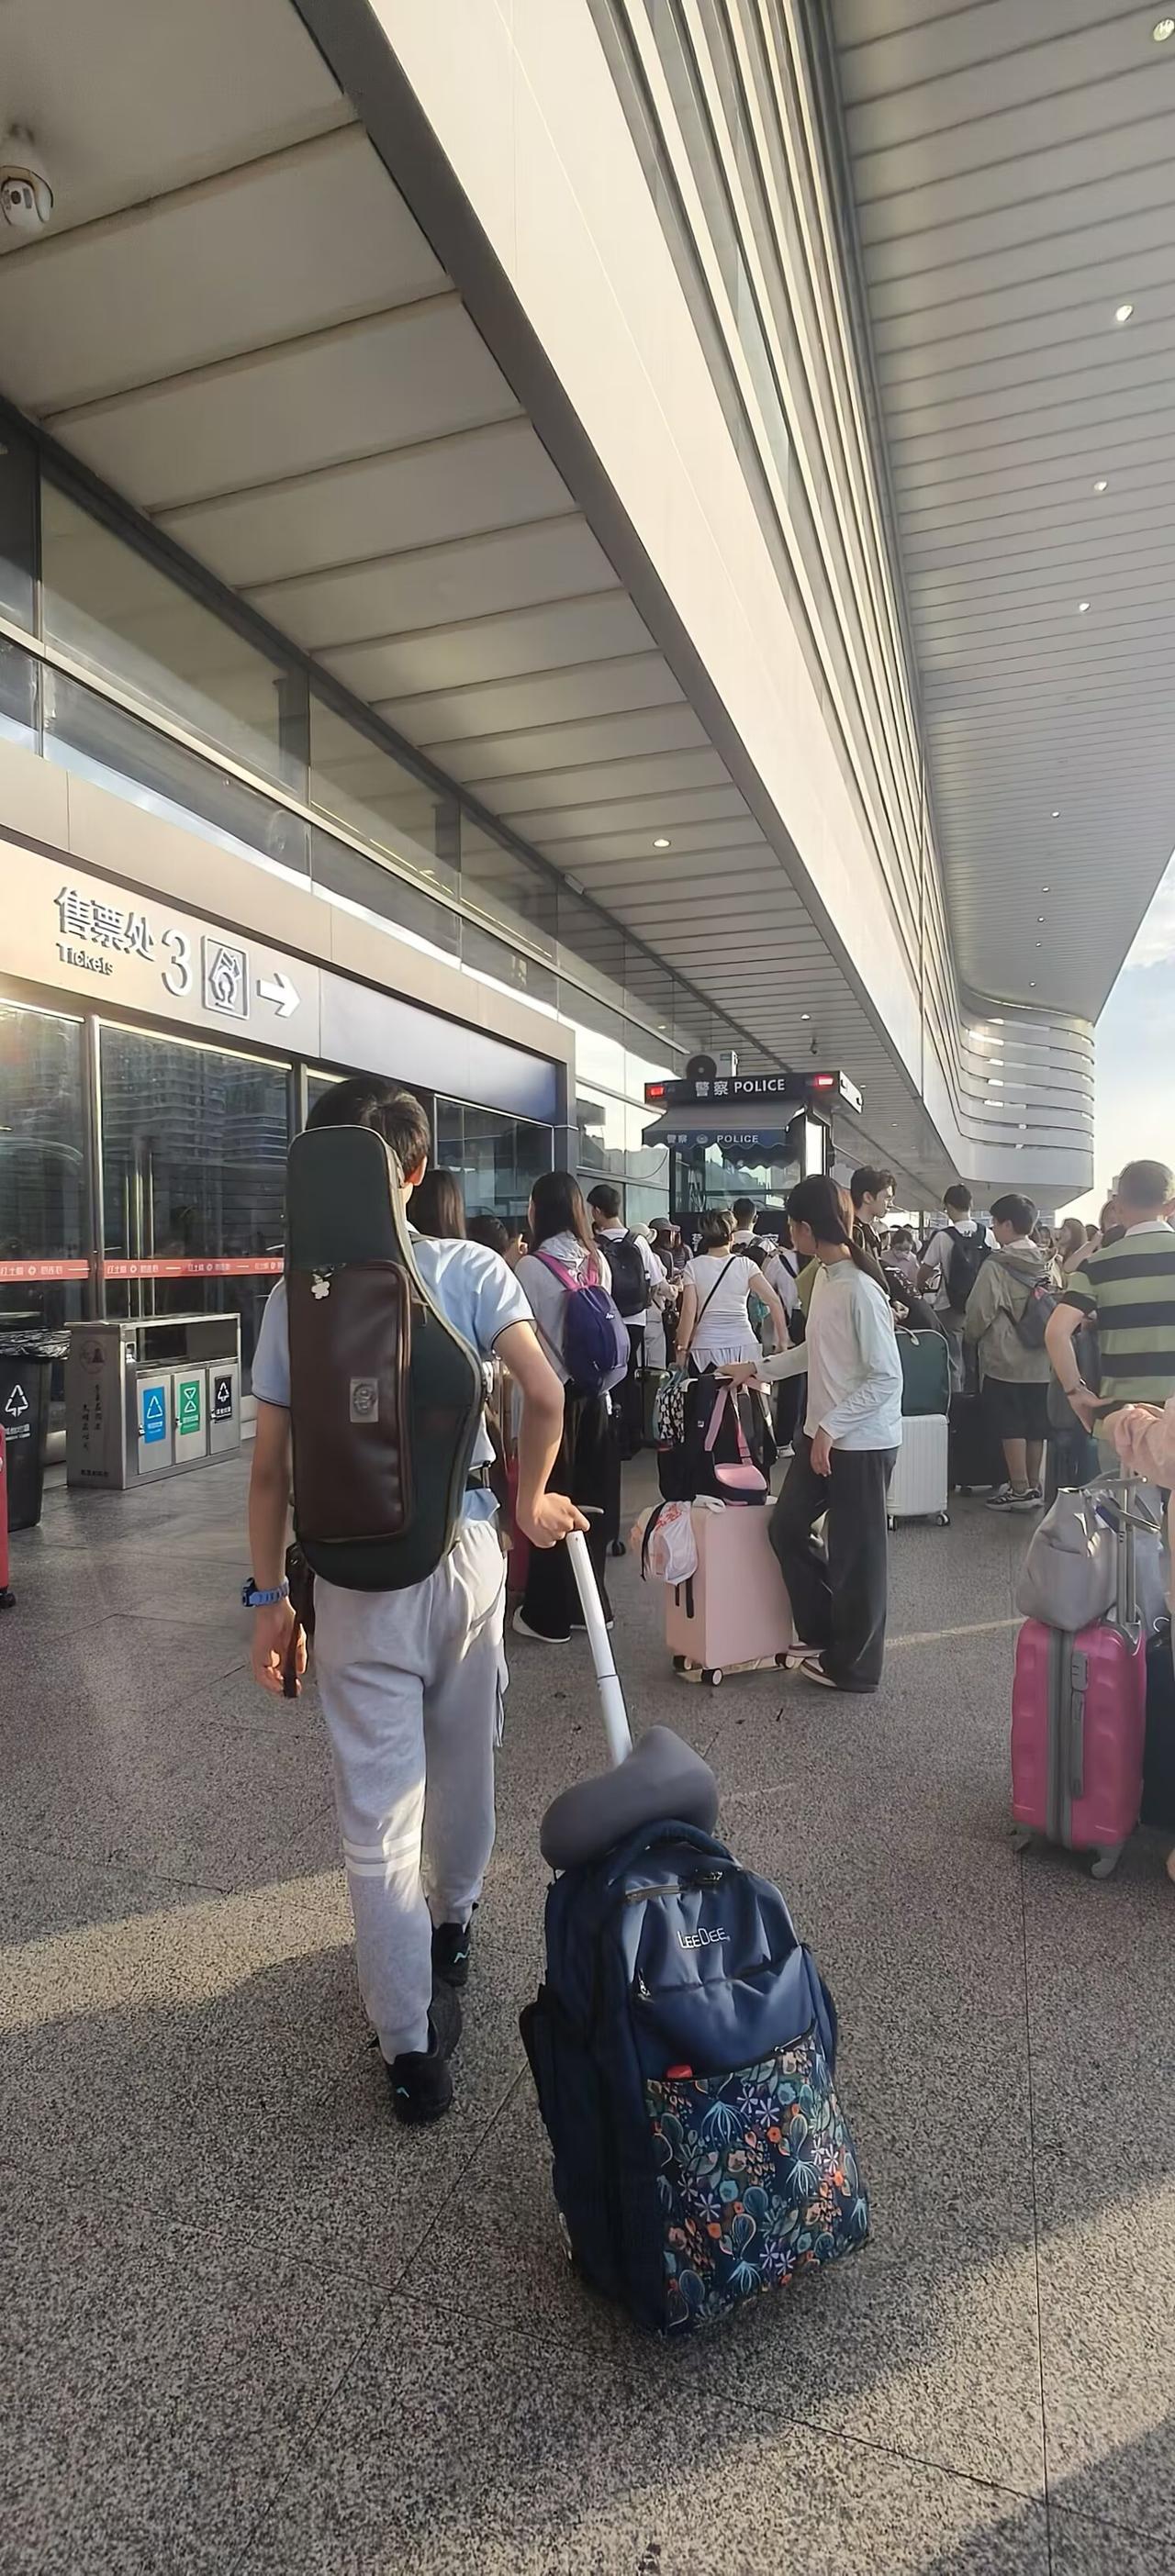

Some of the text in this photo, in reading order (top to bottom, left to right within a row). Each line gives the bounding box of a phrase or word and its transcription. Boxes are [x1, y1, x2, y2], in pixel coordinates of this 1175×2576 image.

[53, 887, 193, 998] 售票处 3
[55, 942, 114, 976] Tickets
[695, 1078, 786, 1098] 警察 POLICE
[716, 1134, 759, 1143] POLICE
